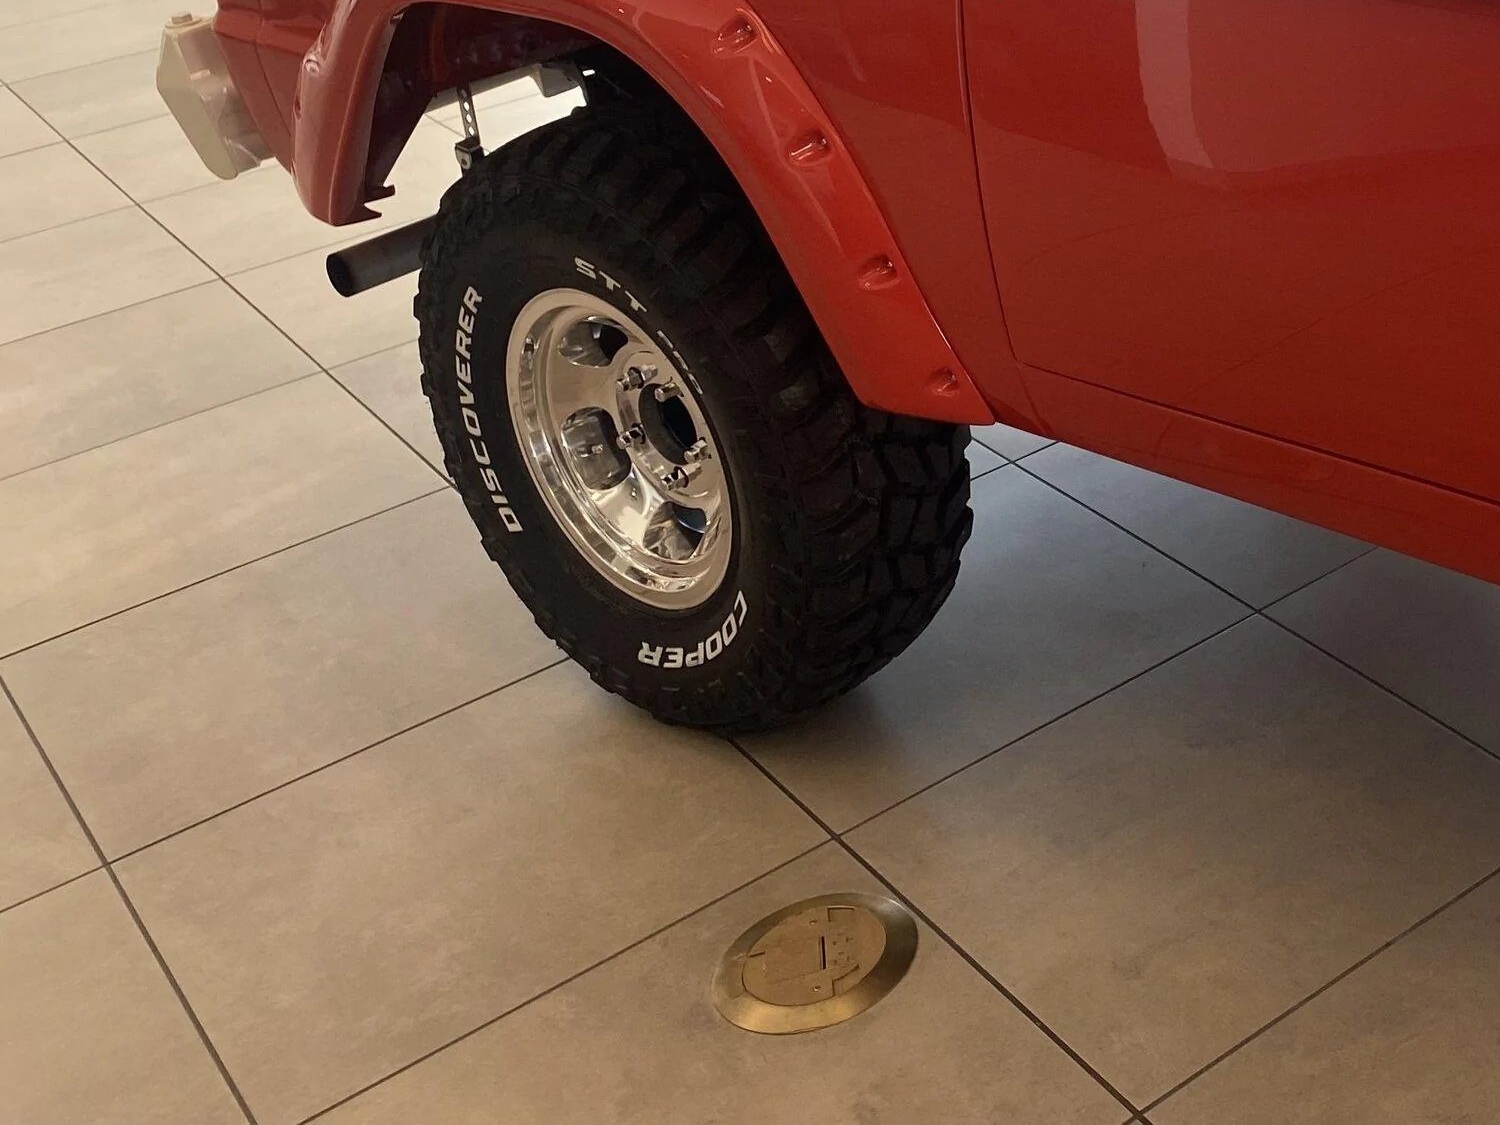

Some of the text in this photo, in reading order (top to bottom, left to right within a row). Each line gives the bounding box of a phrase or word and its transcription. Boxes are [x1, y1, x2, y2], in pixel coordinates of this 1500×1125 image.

[574, 256, 648, 313] STT
[455, 285, 523, 533] DISCOVERER
[637, 589, 748, 669] COOPER
